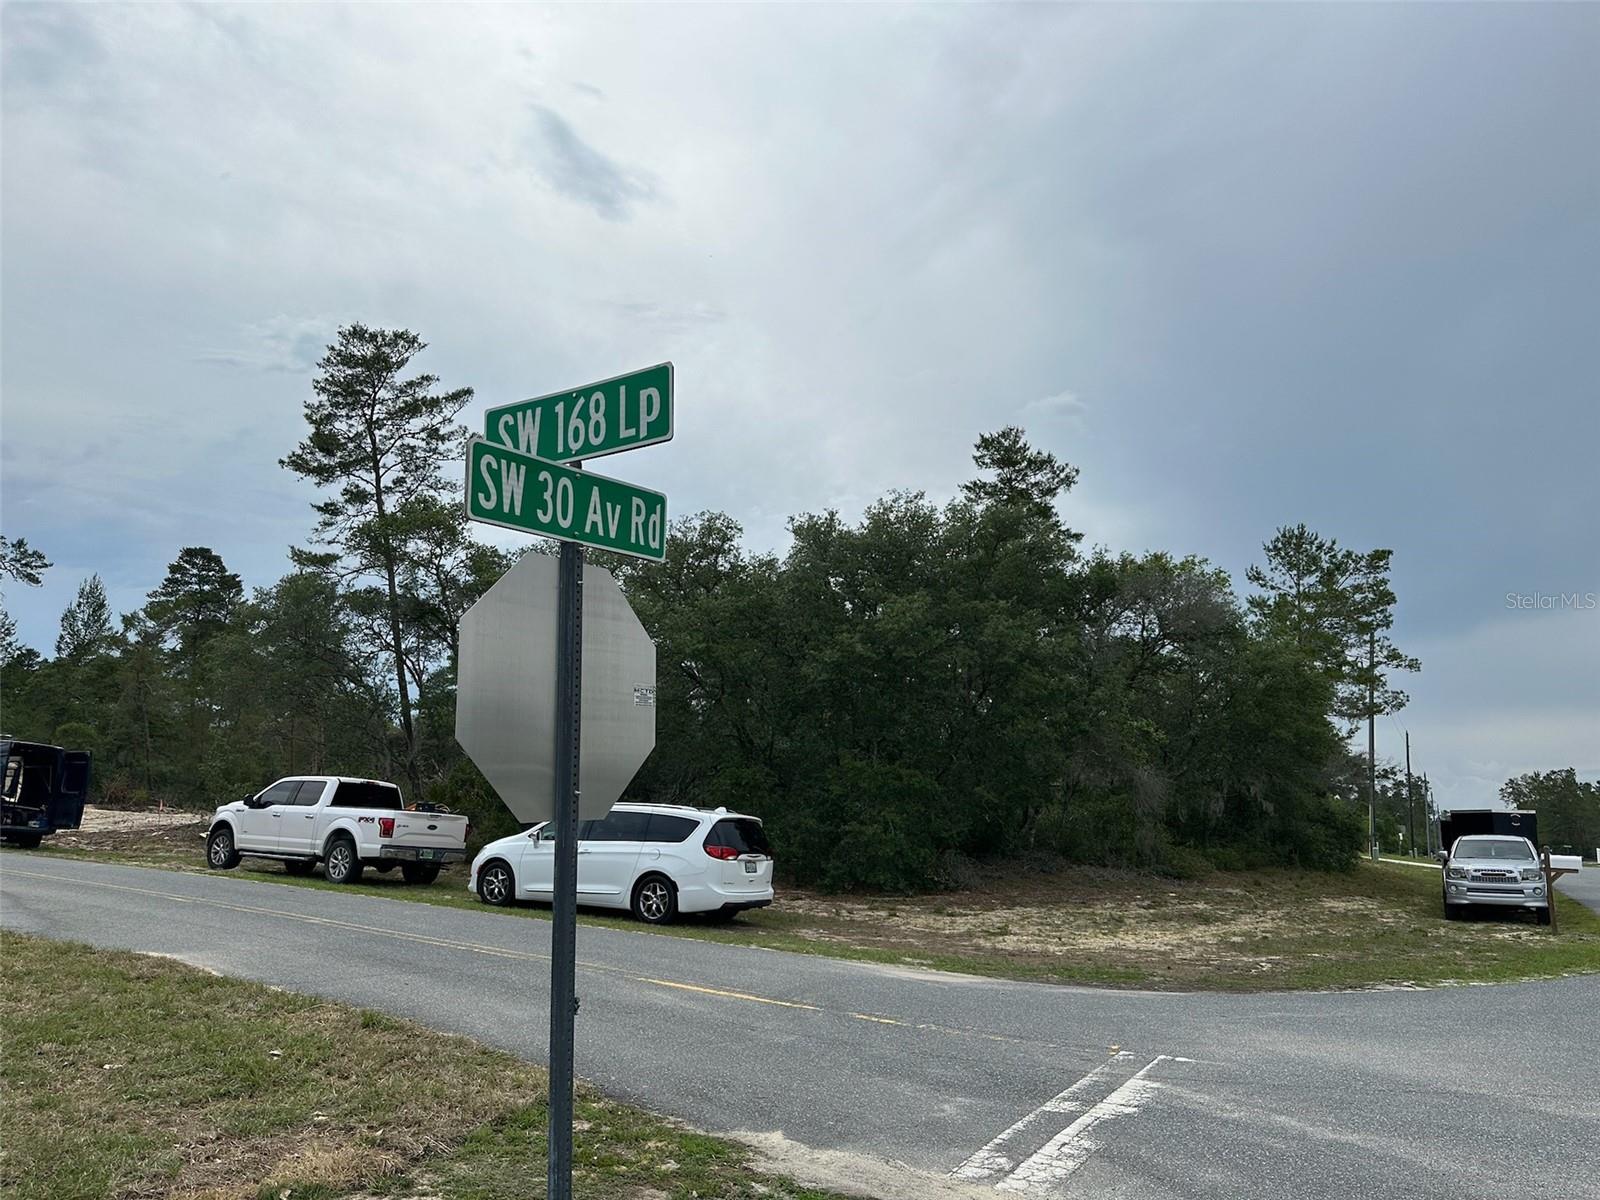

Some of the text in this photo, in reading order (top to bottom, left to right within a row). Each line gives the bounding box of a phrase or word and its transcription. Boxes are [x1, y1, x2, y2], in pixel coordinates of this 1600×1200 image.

[498, 407, 542, 456] SW
[555, 391, 606, 453] 168
[478, 454, 662, 550] SW 30 Av Rd
[358, 816, 375, 824] FX4
